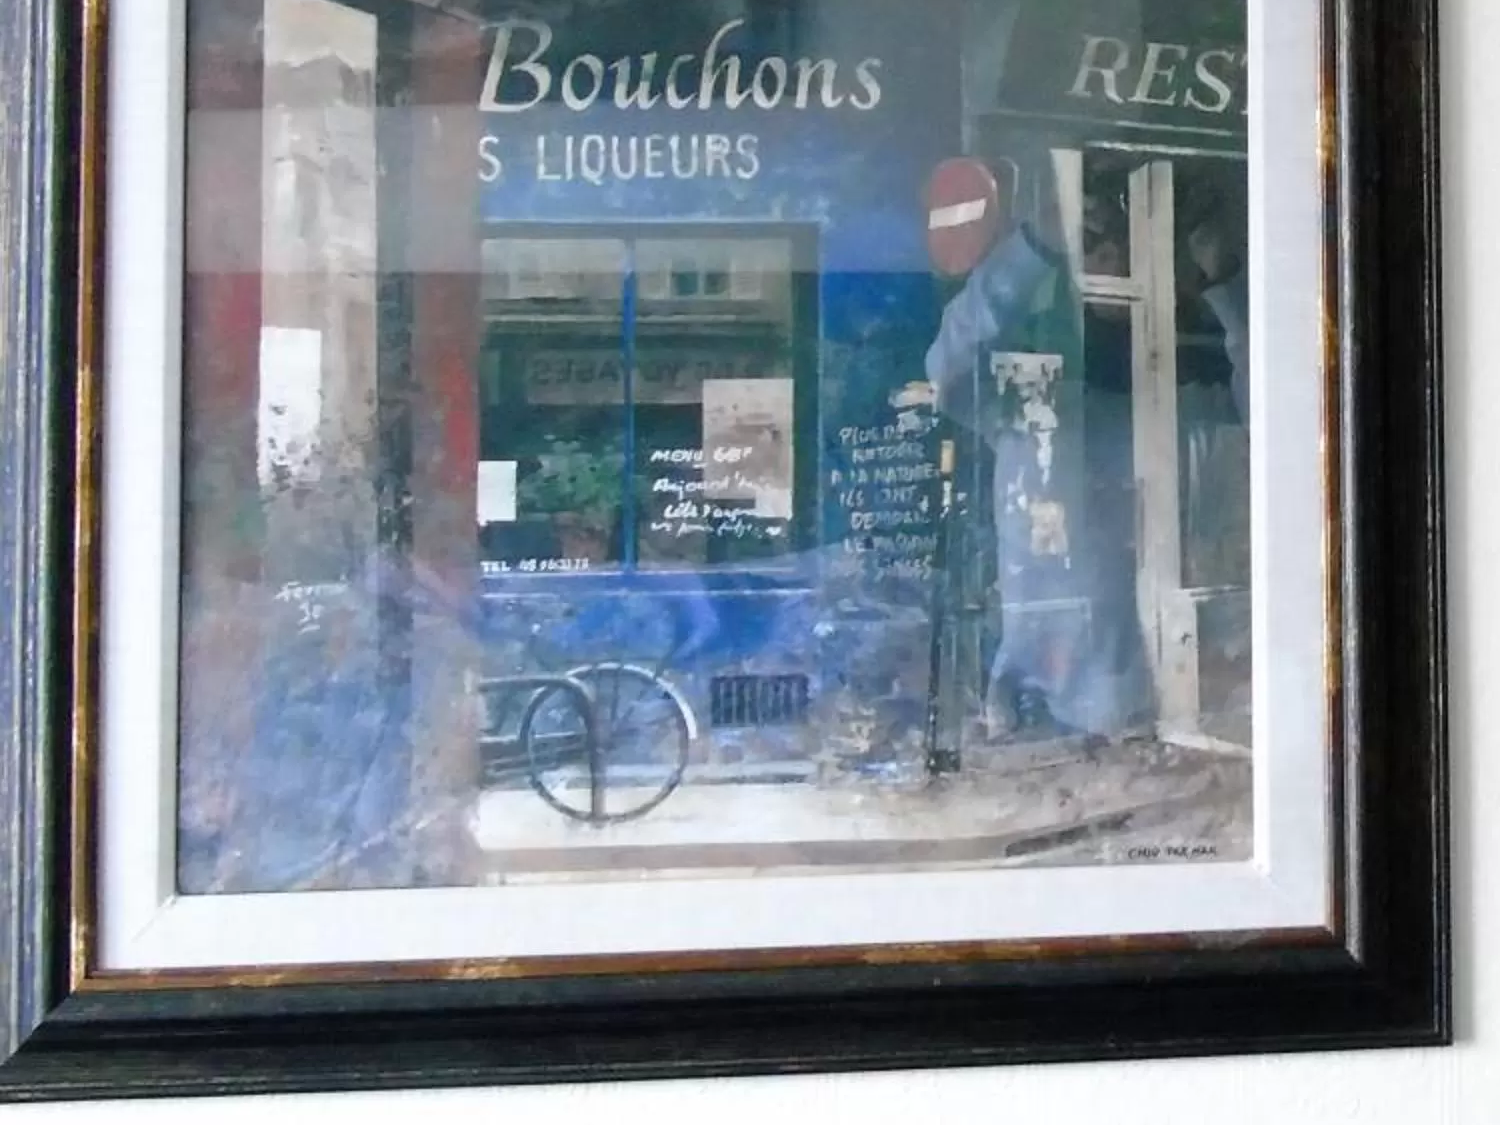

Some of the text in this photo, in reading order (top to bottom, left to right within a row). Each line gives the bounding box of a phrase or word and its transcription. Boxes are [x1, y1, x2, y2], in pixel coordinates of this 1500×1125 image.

[477, 17, 884, 113] Bouchons
[478, 132, 761, 185] S LIQUEURS
[650, 449, 703, 463] MENU
